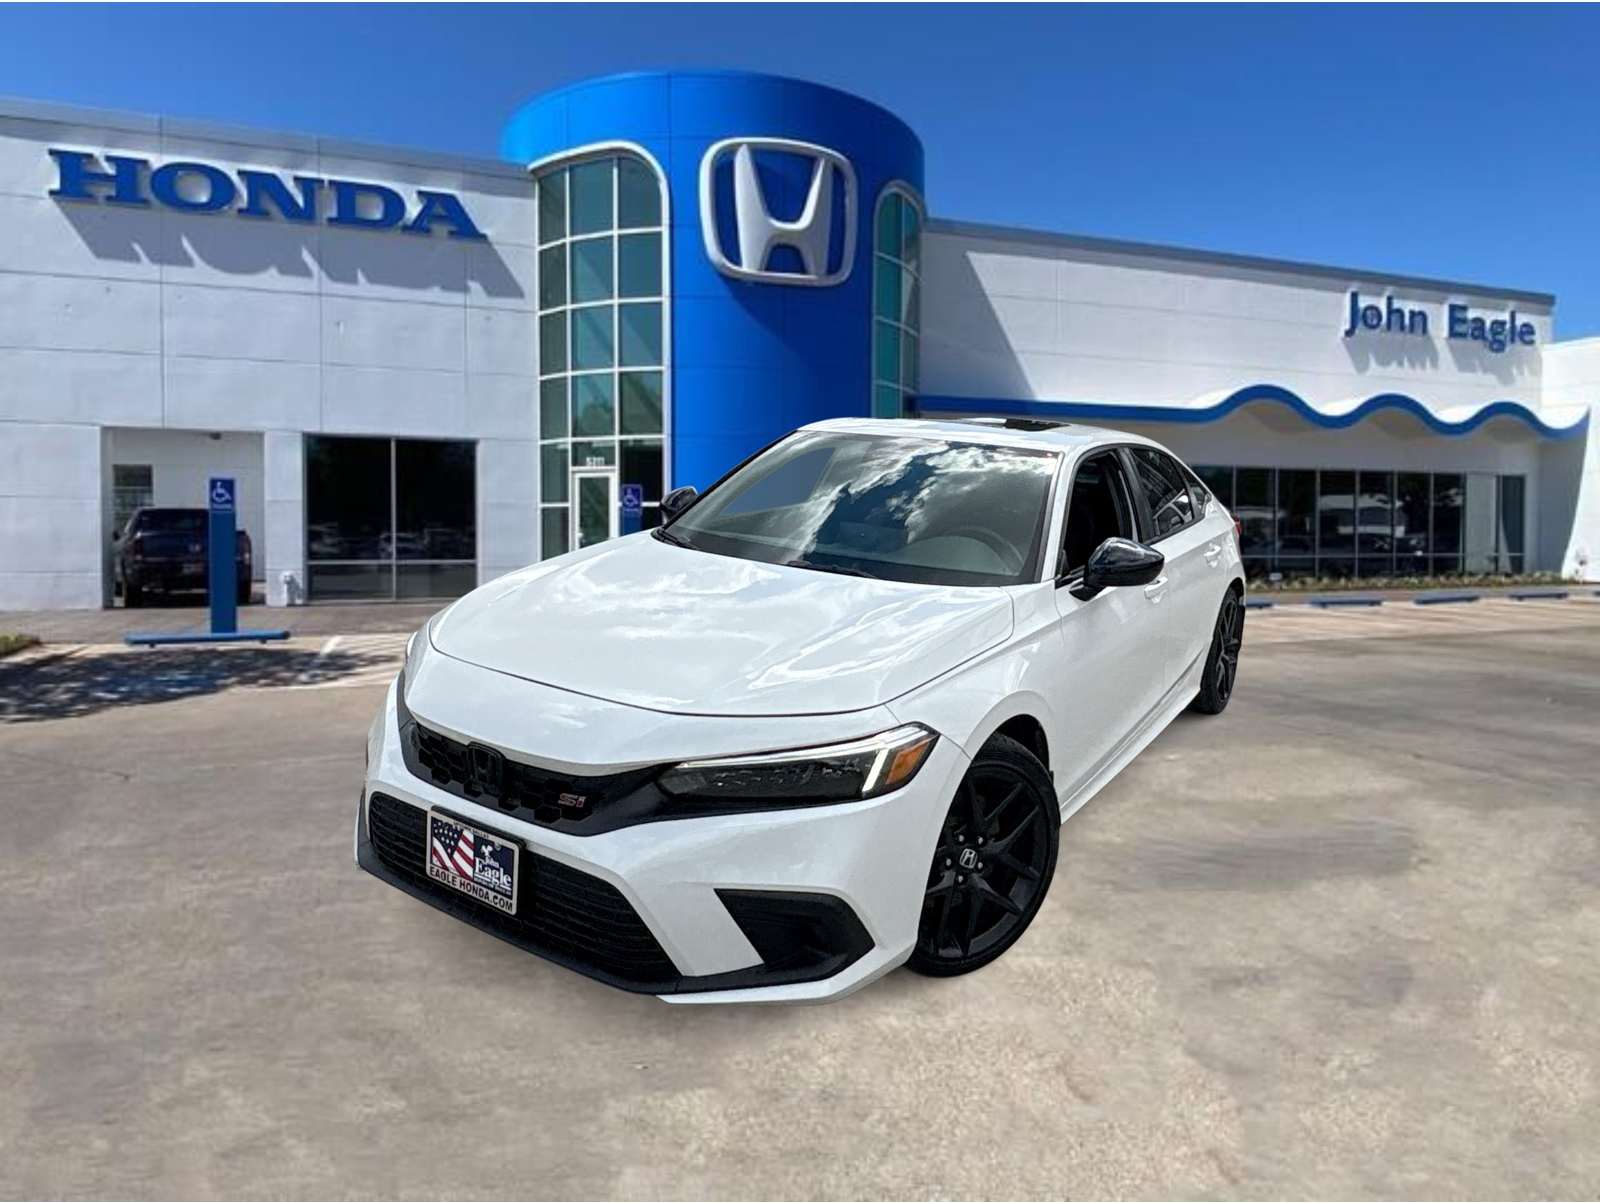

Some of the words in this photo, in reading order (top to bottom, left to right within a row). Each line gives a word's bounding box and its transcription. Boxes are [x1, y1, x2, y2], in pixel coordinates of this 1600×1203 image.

[48, 149, 487, 240] HONDA
[1345, 291, 1428, 337] John
[1449, 303, 1536, 353] Eagle
[474, 856, 512, 887] Eagle
